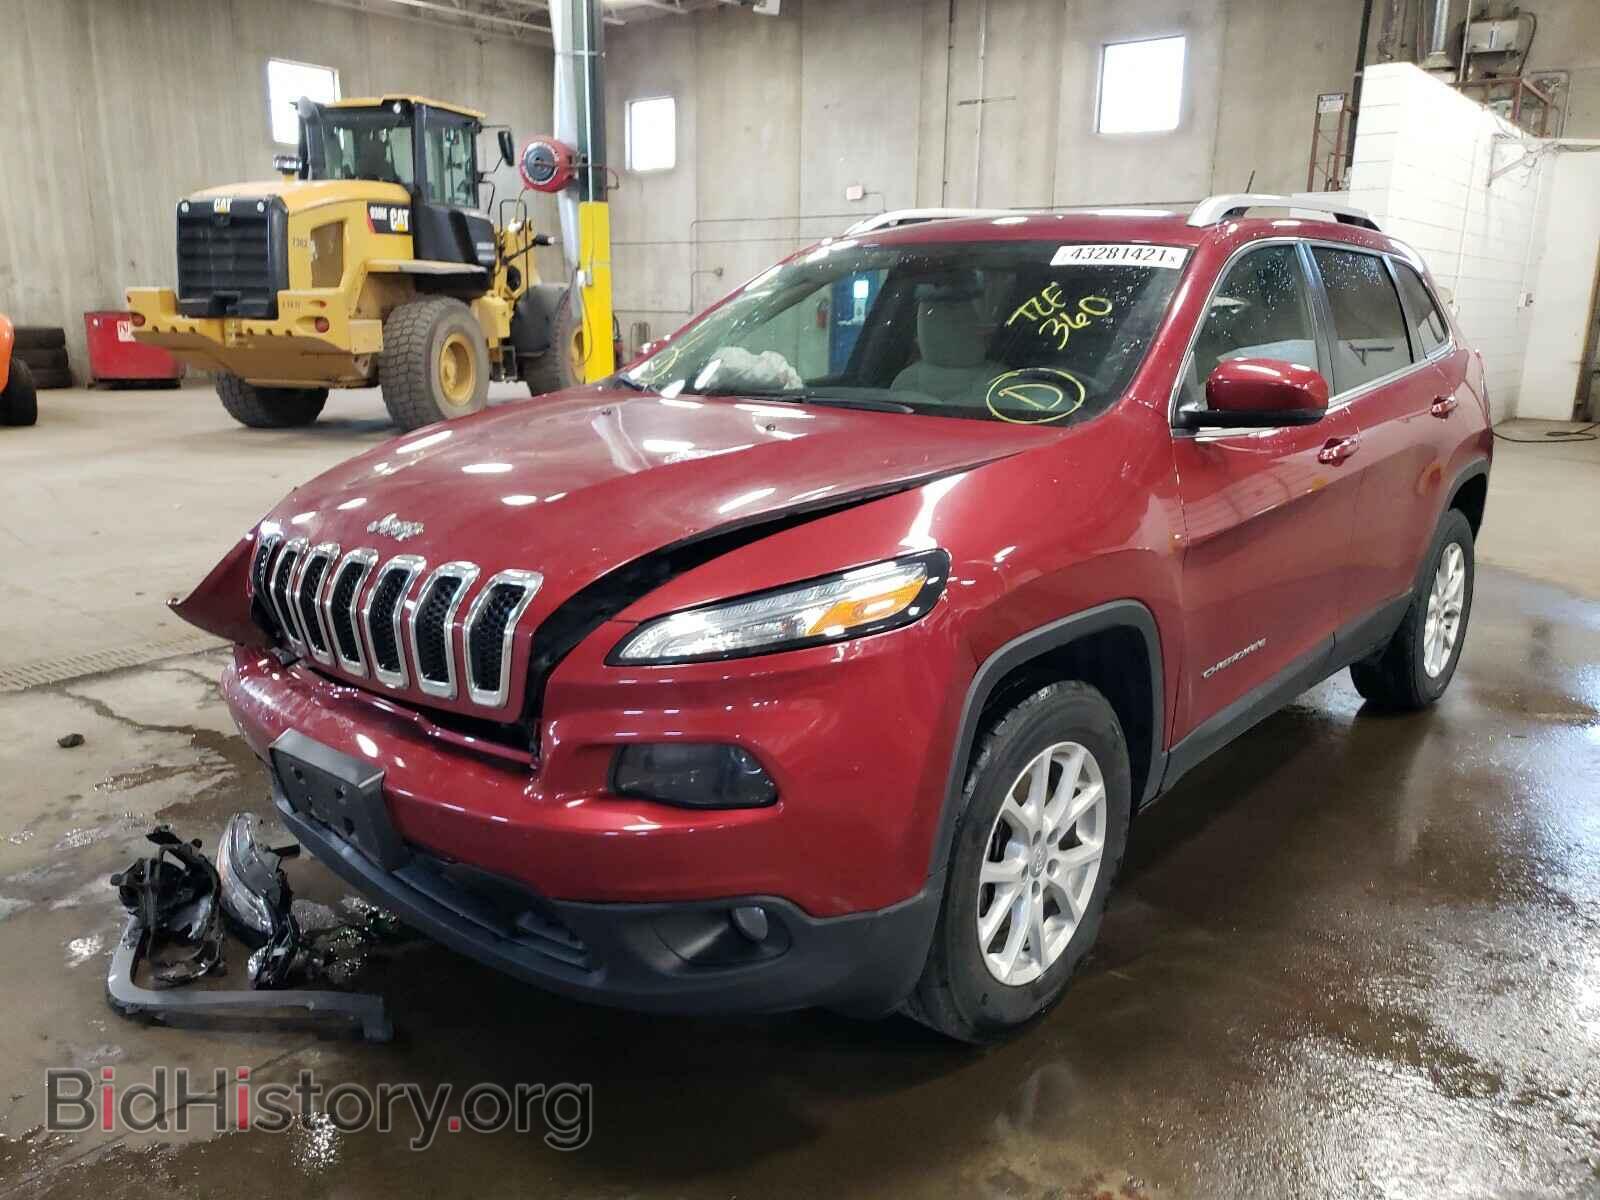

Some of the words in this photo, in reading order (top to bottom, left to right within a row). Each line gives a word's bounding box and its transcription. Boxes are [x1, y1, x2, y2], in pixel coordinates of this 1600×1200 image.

[213, 197, 232, 212] CAT
[389, 207, 410, 231] CAT
[1070, 246, 1167, 263] 43281421
[1038, 295, 1113, 350] 360
